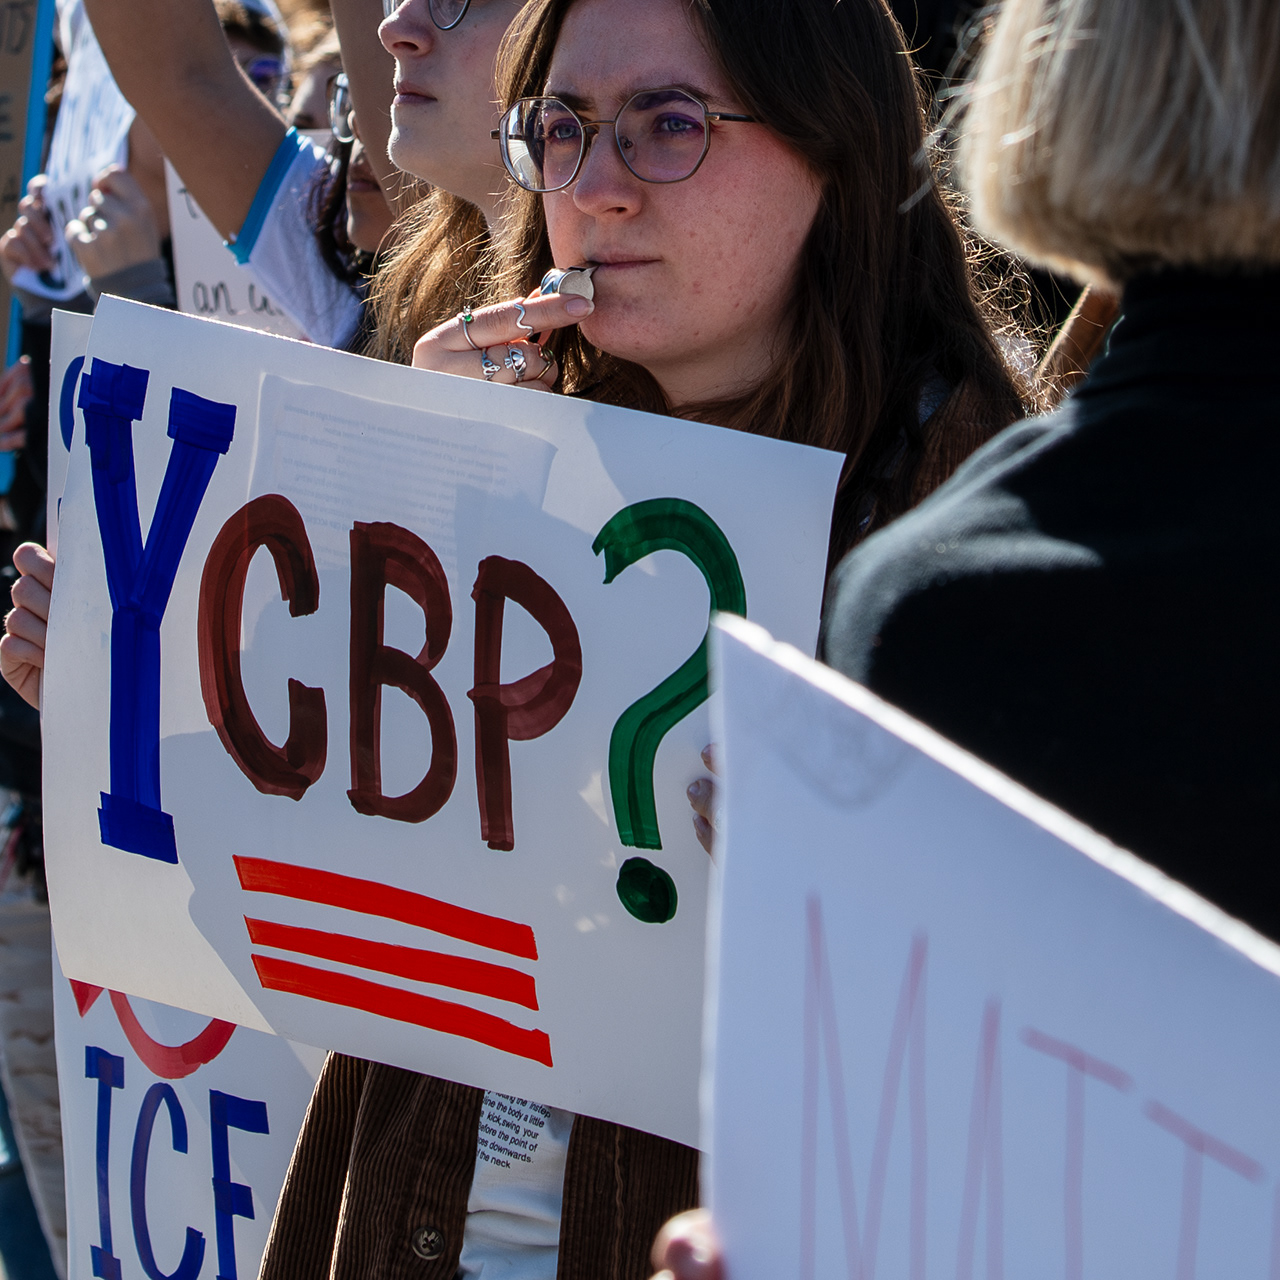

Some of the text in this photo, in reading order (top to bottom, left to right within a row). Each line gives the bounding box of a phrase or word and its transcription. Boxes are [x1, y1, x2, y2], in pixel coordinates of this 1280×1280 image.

[193, 281, 237, 316] an
[77, 356, 748, 924] YCBP?
[496, 1101, 507, 1113] the
[507, 1106, 523, 1121] body
[528, 1114, 545, 1128] little
[529, 1102, 551, 1119] instep
[498, 1130, 509, 1141] the
[509, 1136, 527, 1149] point
[528, 1143, 539, 1153] of
[523, 1128, 539, 1140] your
[480, 1150, 511, 1169] the neck
[489, 1141, 534, 1163] downwards.
